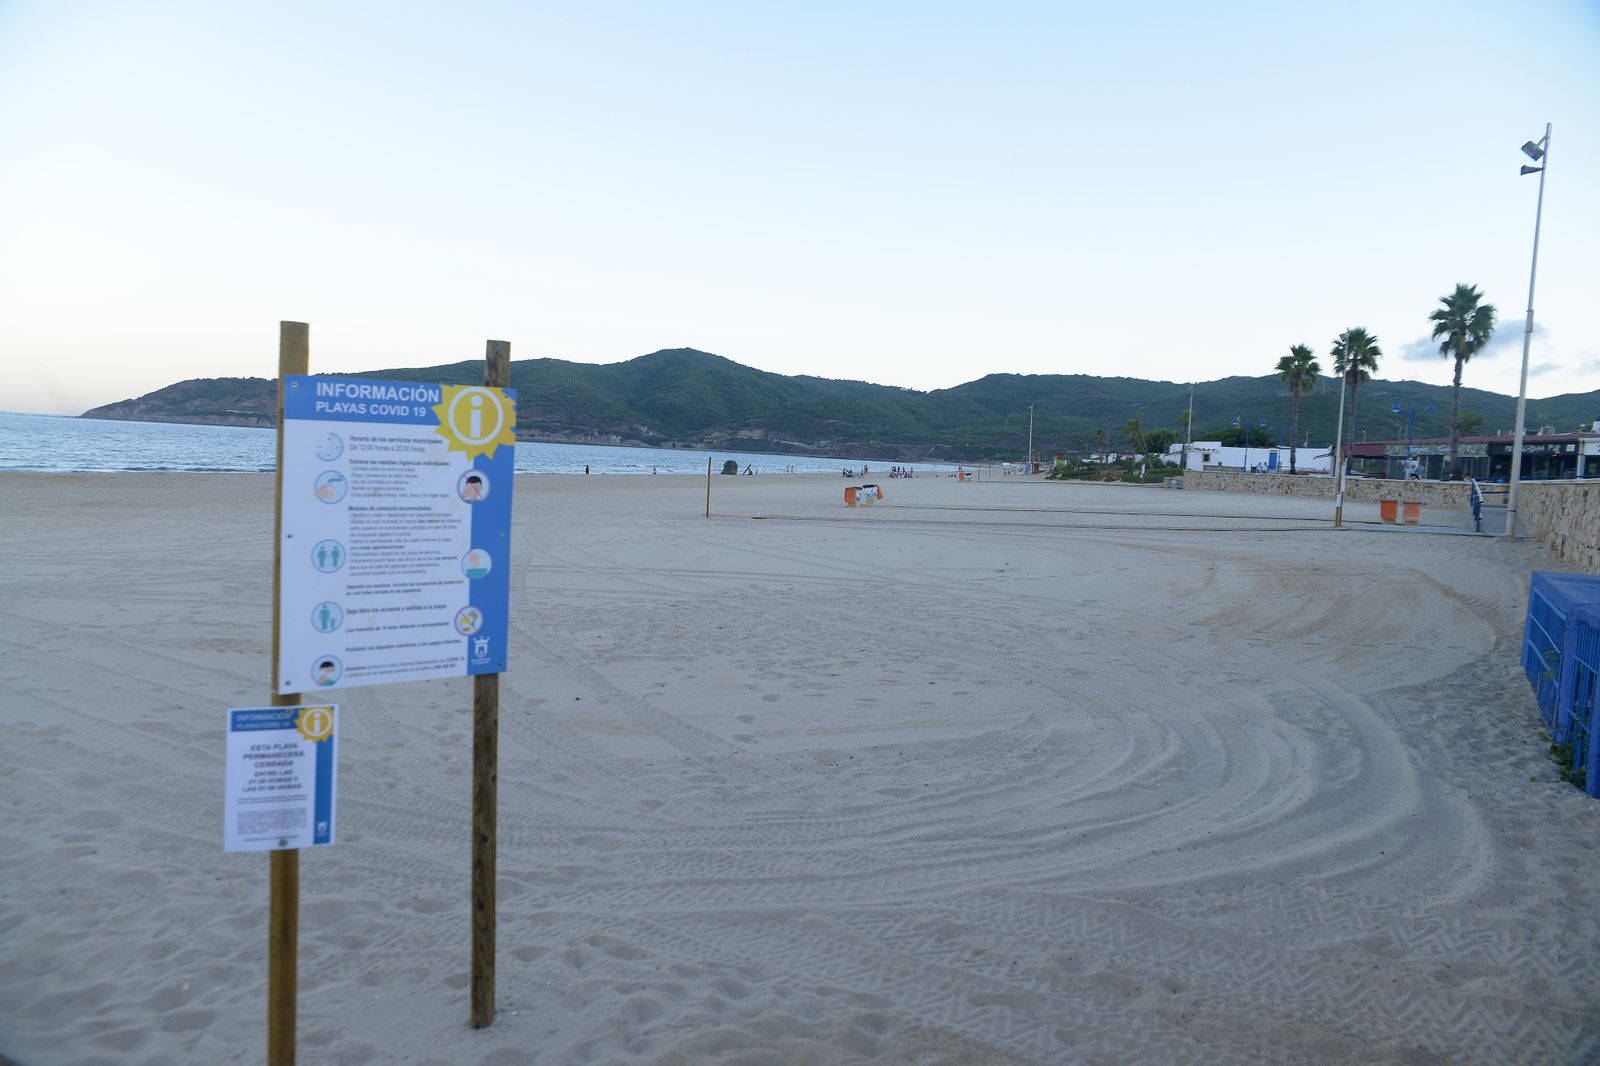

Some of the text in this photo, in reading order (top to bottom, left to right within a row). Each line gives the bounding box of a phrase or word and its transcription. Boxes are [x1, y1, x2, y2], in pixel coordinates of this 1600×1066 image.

[316, 382, 439, 402] INFORMACIÓN
[316, 401, 426, 416] PLAYAS COVID 19
[254, 760, 295, 768] CERRADA
